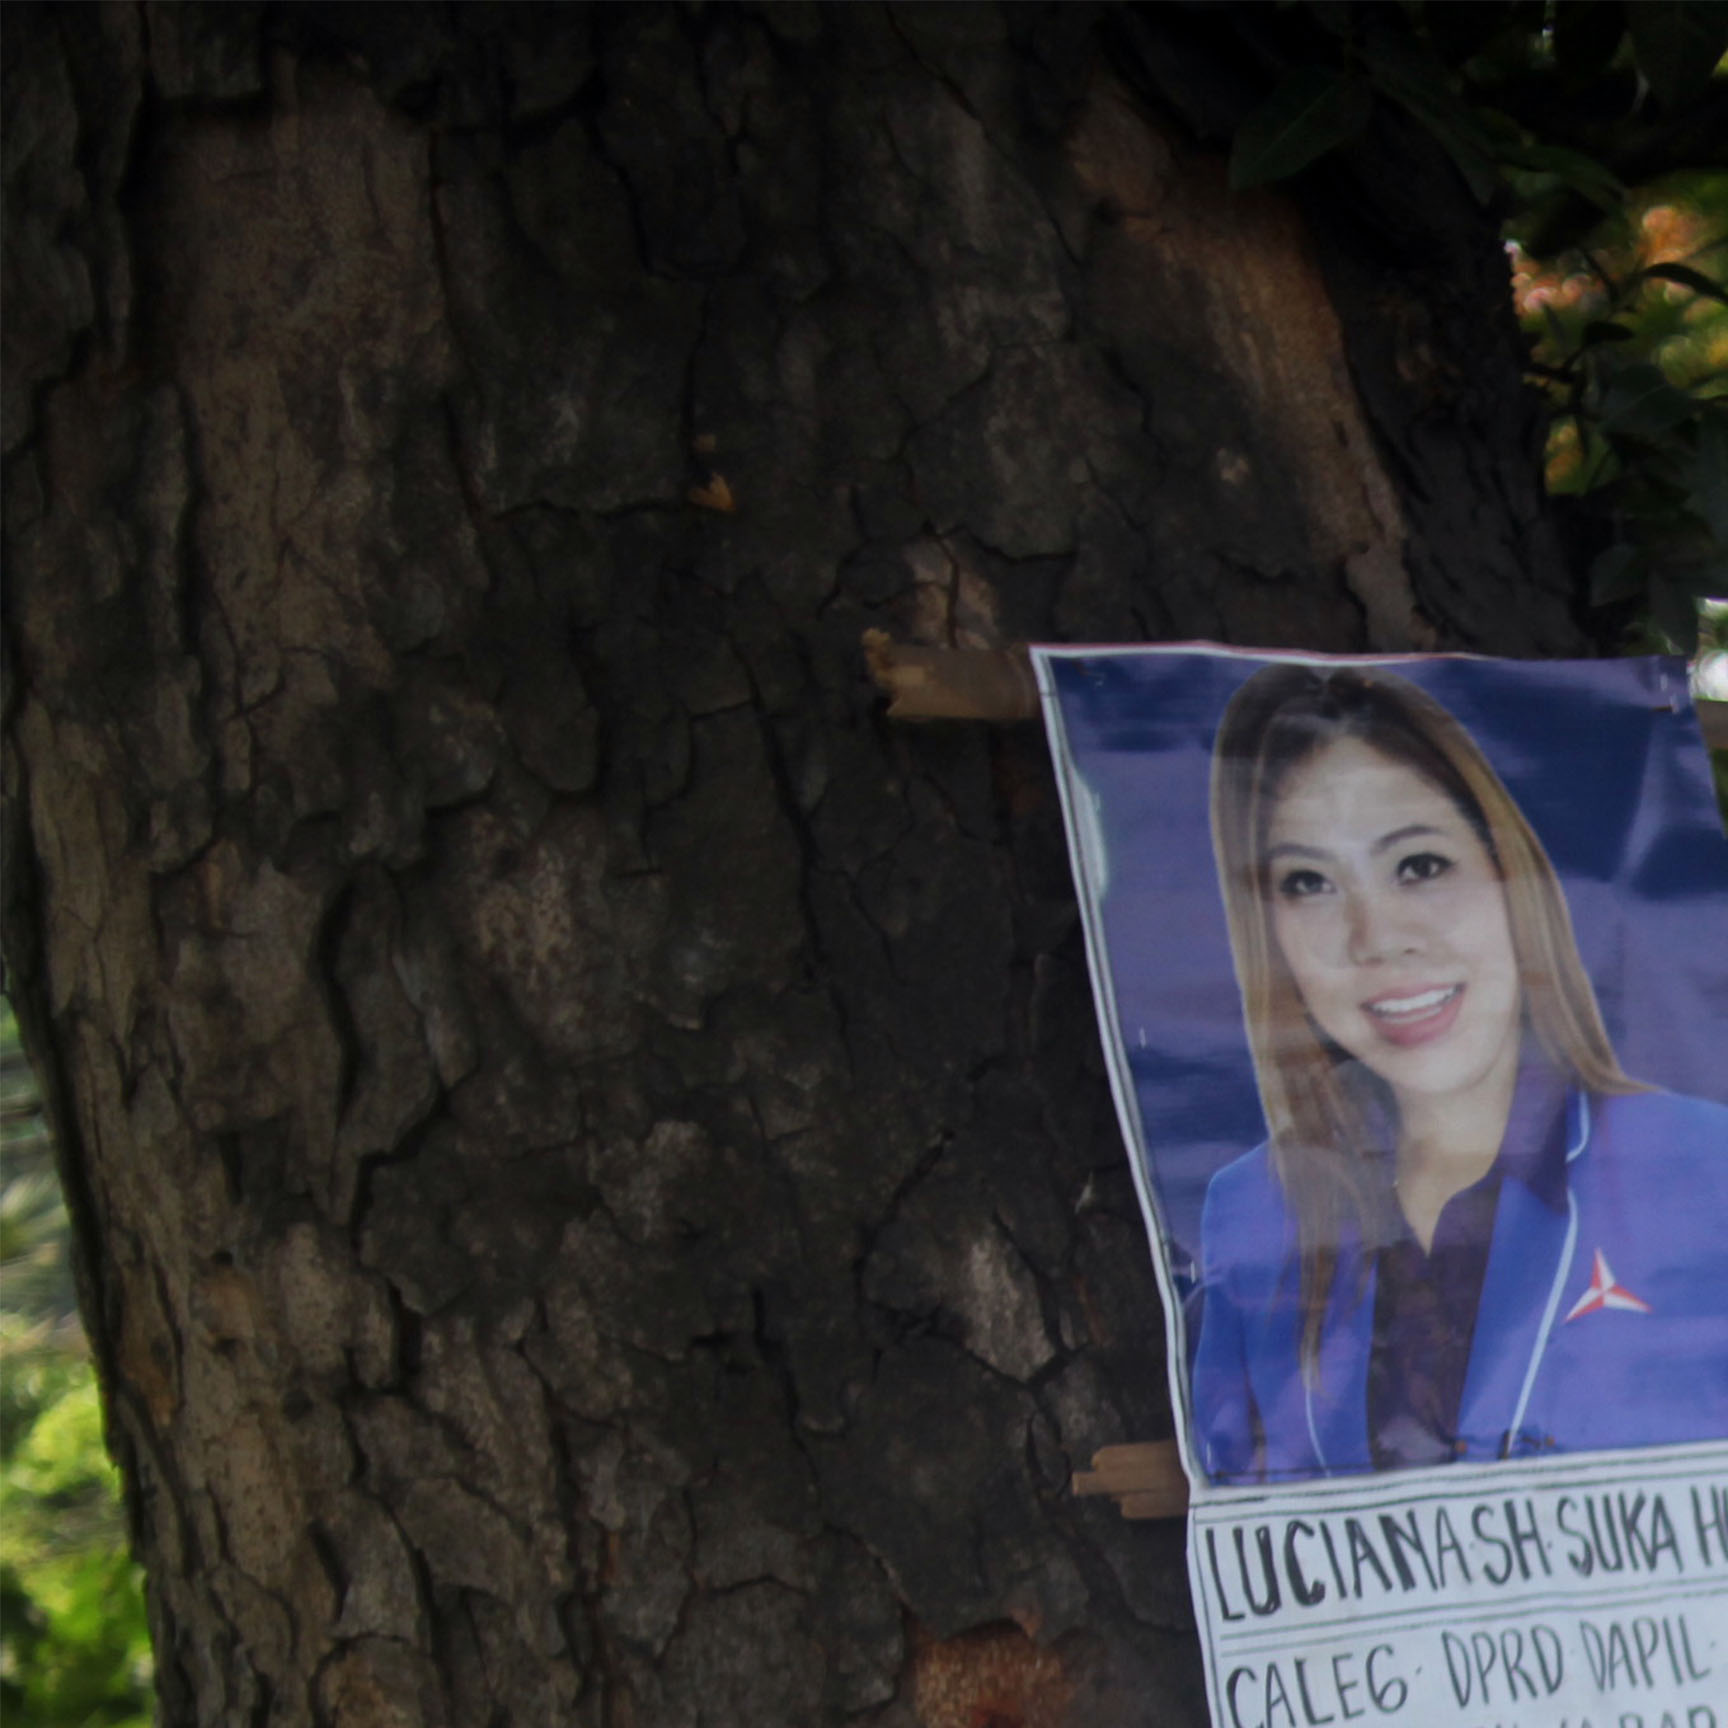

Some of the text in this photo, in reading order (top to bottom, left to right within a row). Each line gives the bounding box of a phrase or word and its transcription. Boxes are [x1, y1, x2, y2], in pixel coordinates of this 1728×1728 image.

[1205, 1505, 1472, 1622] LUCIANA
[1471, 1499, 1552, 1586] SH
[1557, 1486, 1684, 1578] SUKA
[1442, 1624, 1563, 1709] DPRD
[1580, 1614, 1712, 1692] DAPIL
